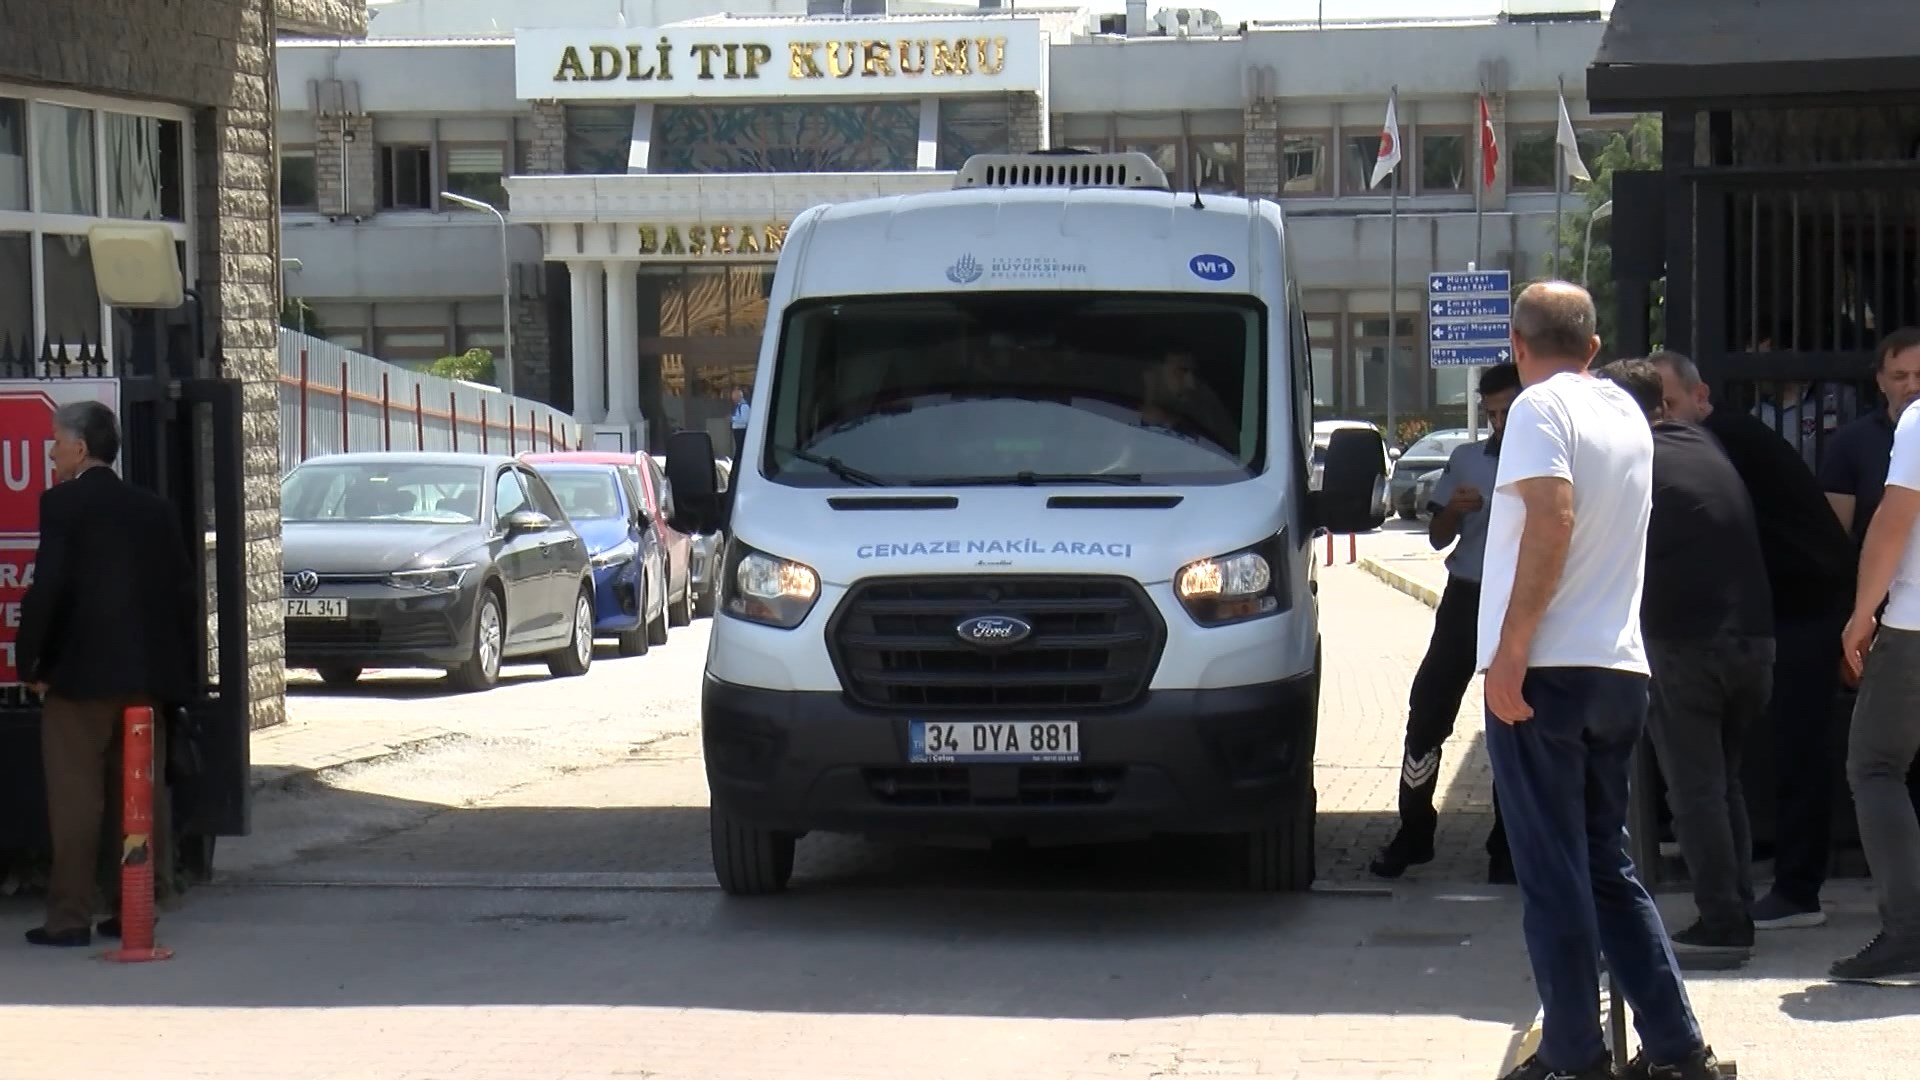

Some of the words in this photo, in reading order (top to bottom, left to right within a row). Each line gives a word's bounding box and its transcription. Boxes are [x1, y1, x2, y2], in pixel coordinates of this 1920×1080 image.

[553, 36, 673, 81] ADLİ
[690, 43, 772, 80] TIP
[788, 37, 1007, 79] KURUMU
[1197, 261, 1229, 273] M1
[857, 540, 960, 559] CENAZE
[967, 538, 1046, 554] NAKİL
[1051, 541, 1132, 558] ARACI
[287, 600, 312, 615] FZL
[318, 600, 342, 615] 341
[973, 619, 1012, 638] Ford
[928, 724, 958, 751] 34
[973, 724, 1019, 751] DYA
[1030, 724, 1072, 751] 881
